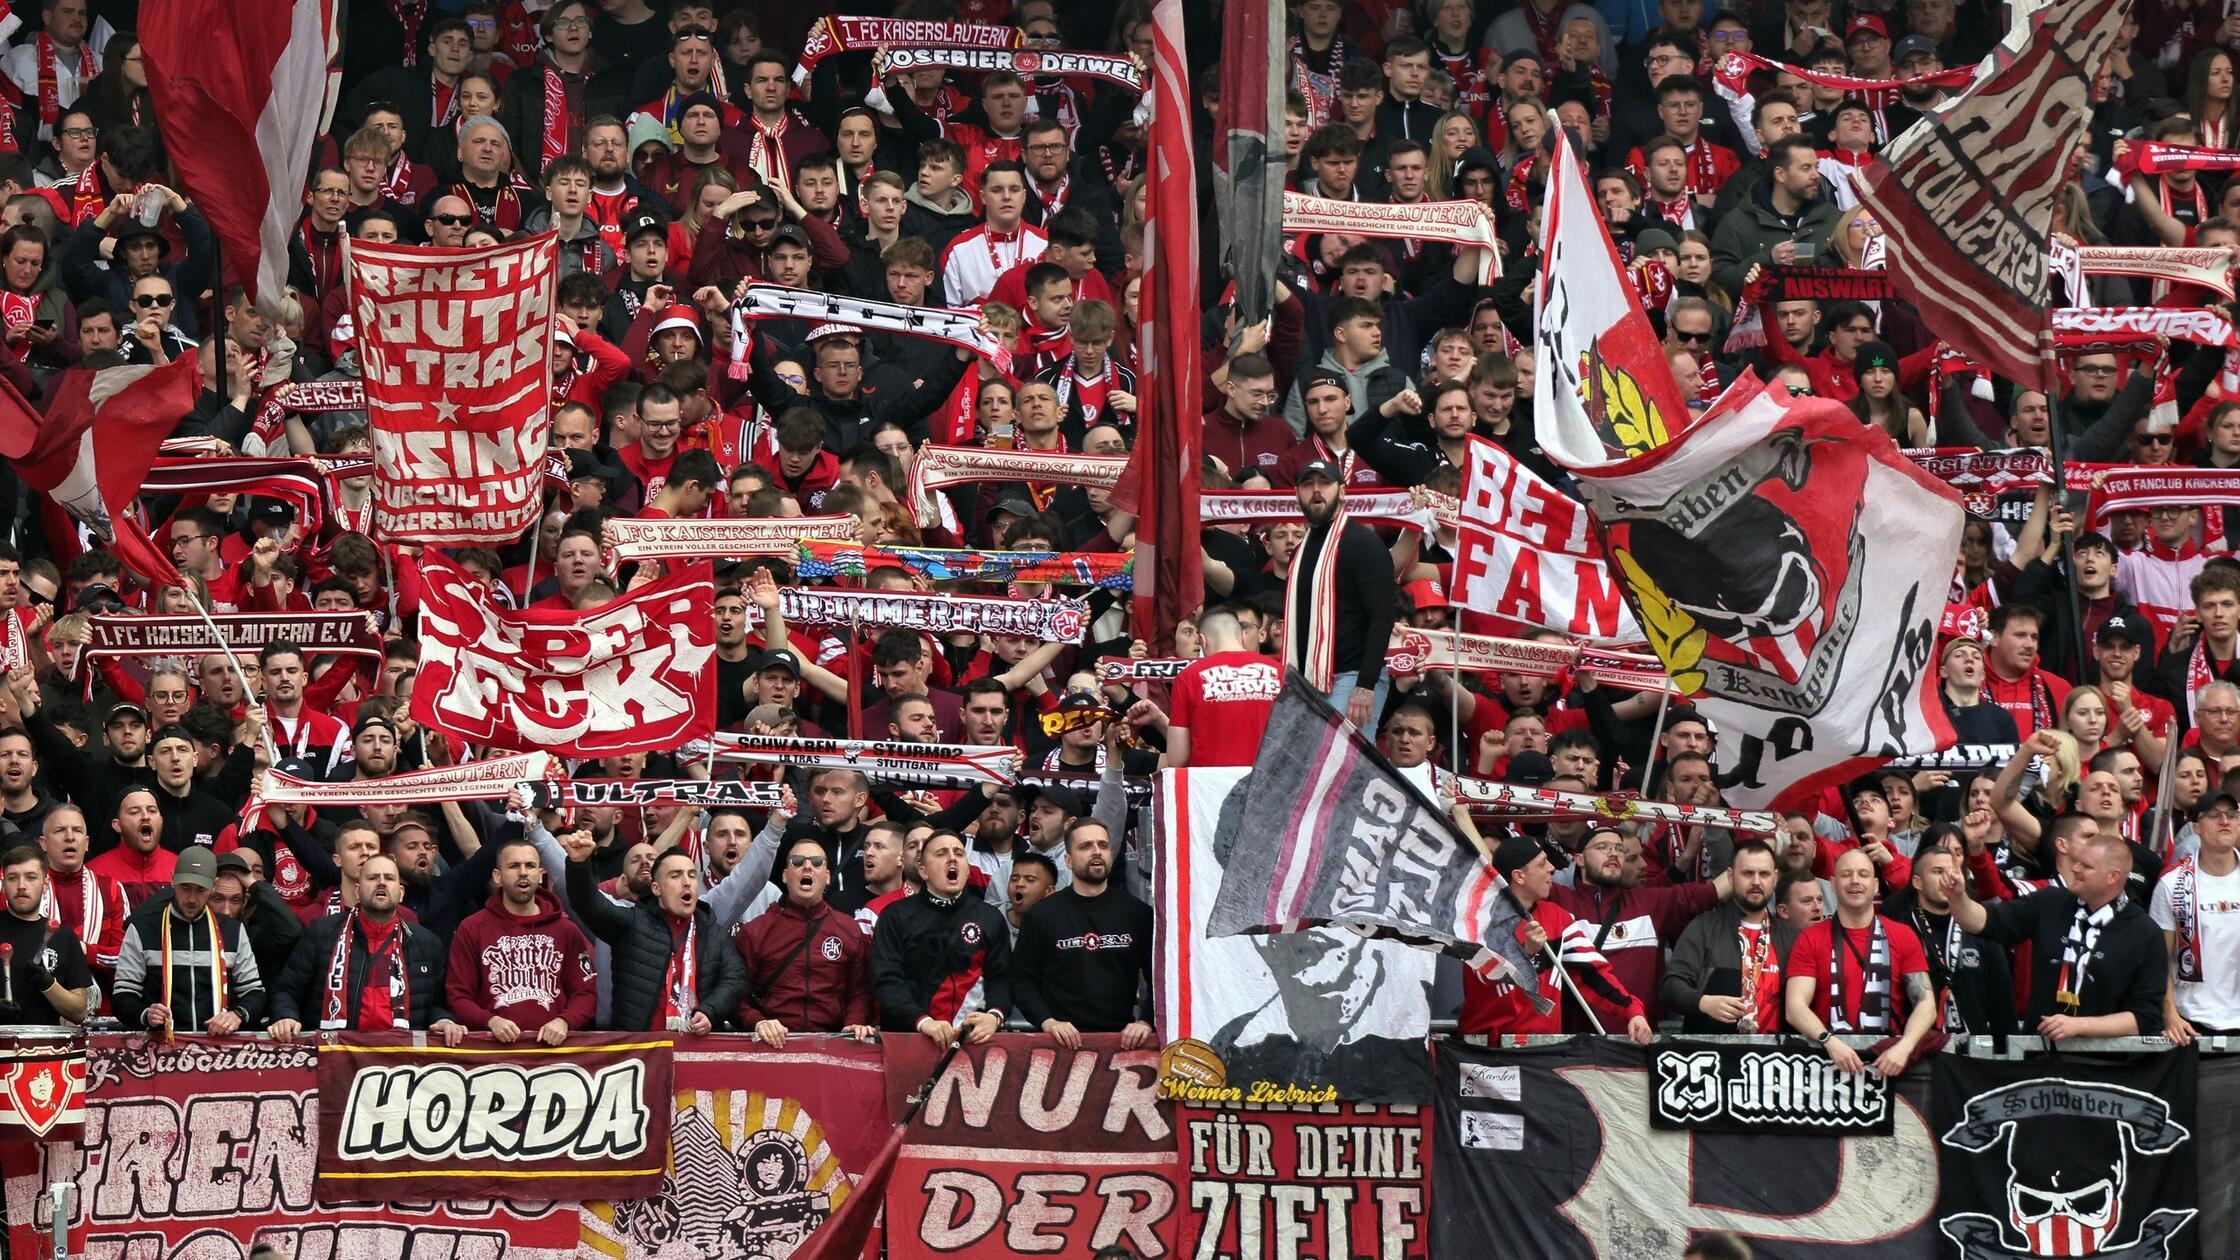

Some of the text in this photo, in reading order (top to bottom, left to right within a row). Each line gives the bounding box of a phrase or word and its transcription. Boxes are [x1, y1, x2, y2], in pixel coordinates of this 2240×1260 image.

[859, 22, 880, 41] FC
[883, 22, 1009, 47] KAISERSLAUTERN
[1298, 197, 1482, 227] KAISERSLAUTERN
[1289, 217, 1315, 225] VEREIN
[1317, 218, 1345, 227] VOLLER
[1348, 221, 1396, 231] GESCHICHTE
[1397, 223, 1414, 231] UND
[1417, 225, 1457, 234] LEGENDEN
[2146, 263, 2188, 274] LEGENDEN
[359, 322, 548, 389] ULTRAS
[1024, 472, 1078, 482] GESCHICHTE
[2132, 478, 2182, 490] FANCLUB
[685, 543, 717, 551] VOLLER
[146, 621, 317, 646] KAISERSLAUTERN
[319, 621, 355, 643] E.V.
[1468, 656, 1482, 664] EIN
[1483, 657, 1513, 667] VEREIN
[1515, 661, 1543, 670] VOLLER
[1598, 671, 1660, 685] UND LEGENDEN
[738, 736, 838, 754] SCHWABEN
[779, 754, 942, 772] ULTRAS STUTTGART
[317, 790, 348, 798] VEREIN
[384, 787, 437, 796] GESCHICHTE
[460, 783, 505, 792] LEGENDEN
[573, 780, 786, 805] ULTRAS
[923, 1046, 1171, 1142] NUR
[1163, 1076, 1340, 1104] Werner Liebrich
[1656, 1050, 1888, 1127] 25 JAHRE
[340, 1060, 650, 1161] HORDA
[2002, 1088, 2125, 1119] Schwaben
[1189, 1113, 1422, 1179] FÜR DEINE
[919, 1170, 1177, 1260] DER
